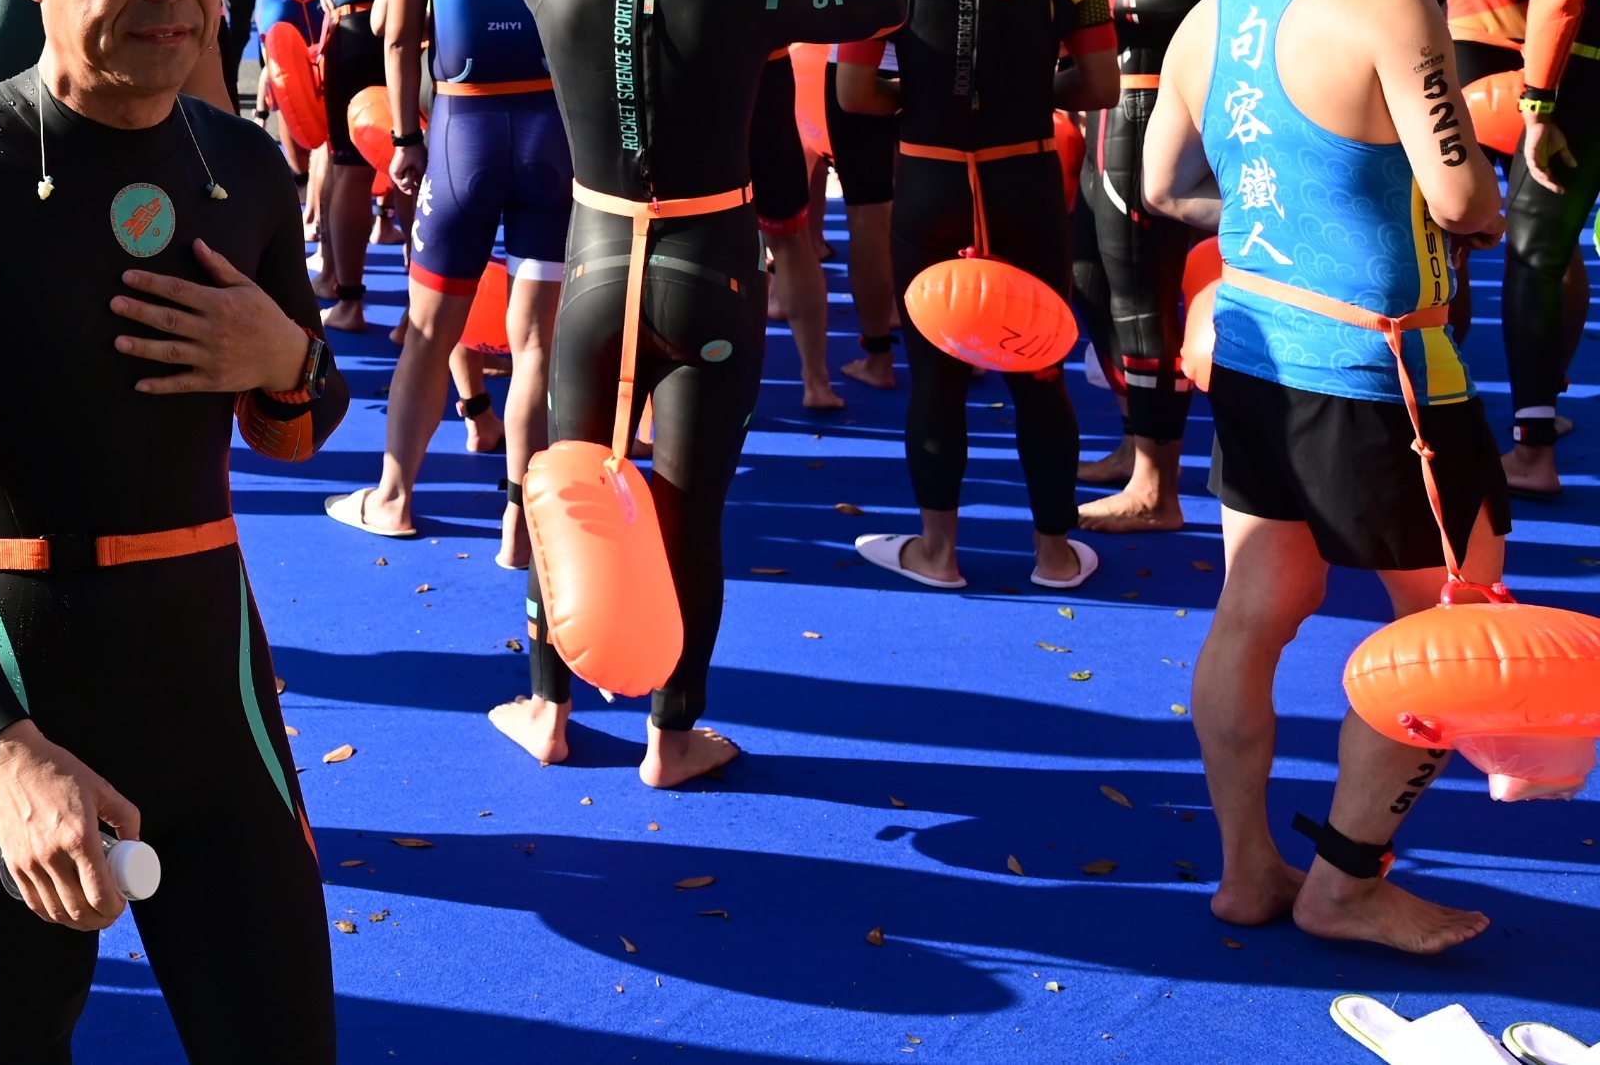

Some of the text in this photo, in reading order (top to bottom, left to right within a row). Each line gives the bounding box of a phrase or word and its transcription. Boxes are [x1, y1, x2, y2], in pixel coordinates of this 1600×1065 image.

[487, 22, 522, 31] ZHIYI
[956, 13, 973, 56] SCIENCE
[614, 47, 635, 100] SCIENCE
[618, 102, 639, 151] ROCKET
[1224, 6, 1293, 266] 句容鐵人
[1423, 68, 1467, 168] 525
